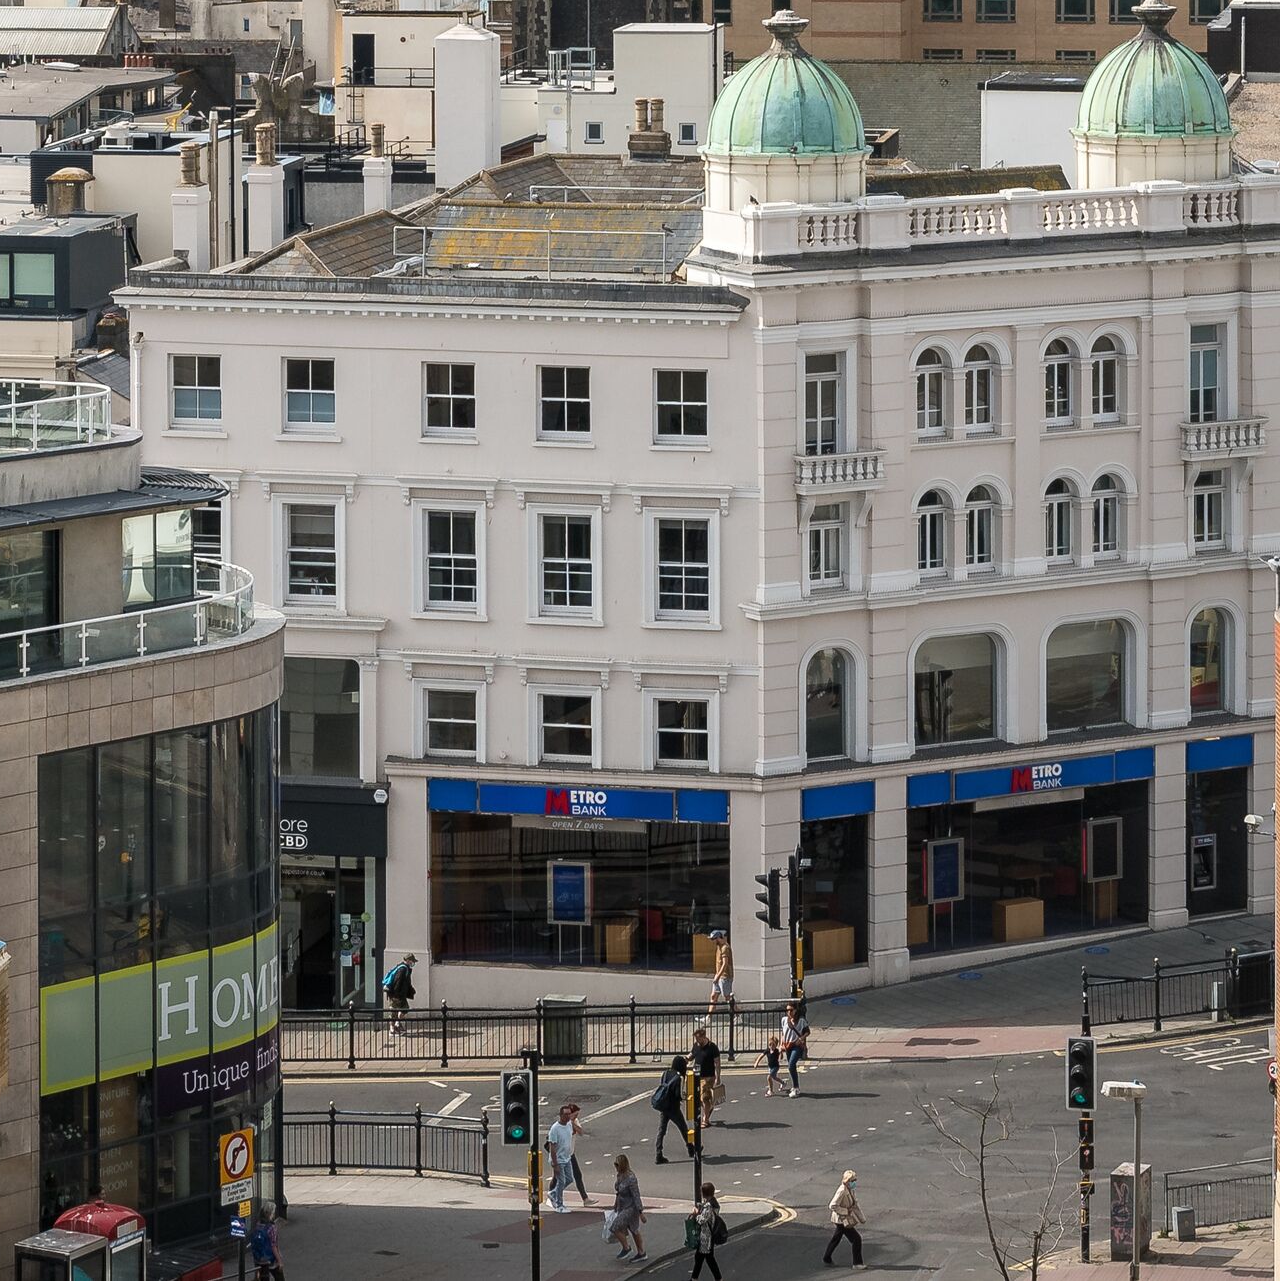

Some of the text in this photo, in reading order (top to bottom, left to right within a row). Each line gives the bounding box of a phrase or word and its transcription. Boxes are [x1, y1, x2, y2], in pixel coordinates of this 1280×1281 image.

[1011, 763, 1062, 793] METRO
[1033, 777, 1062, 790] BANK
[544, 788, 607, 815] METRO
[572, 805, 607, 816] BANK
[576, 820, 582, 828] 7
[584, 822, 604, 830] DAYS
[183, 1061, 250, 1094] Unique
